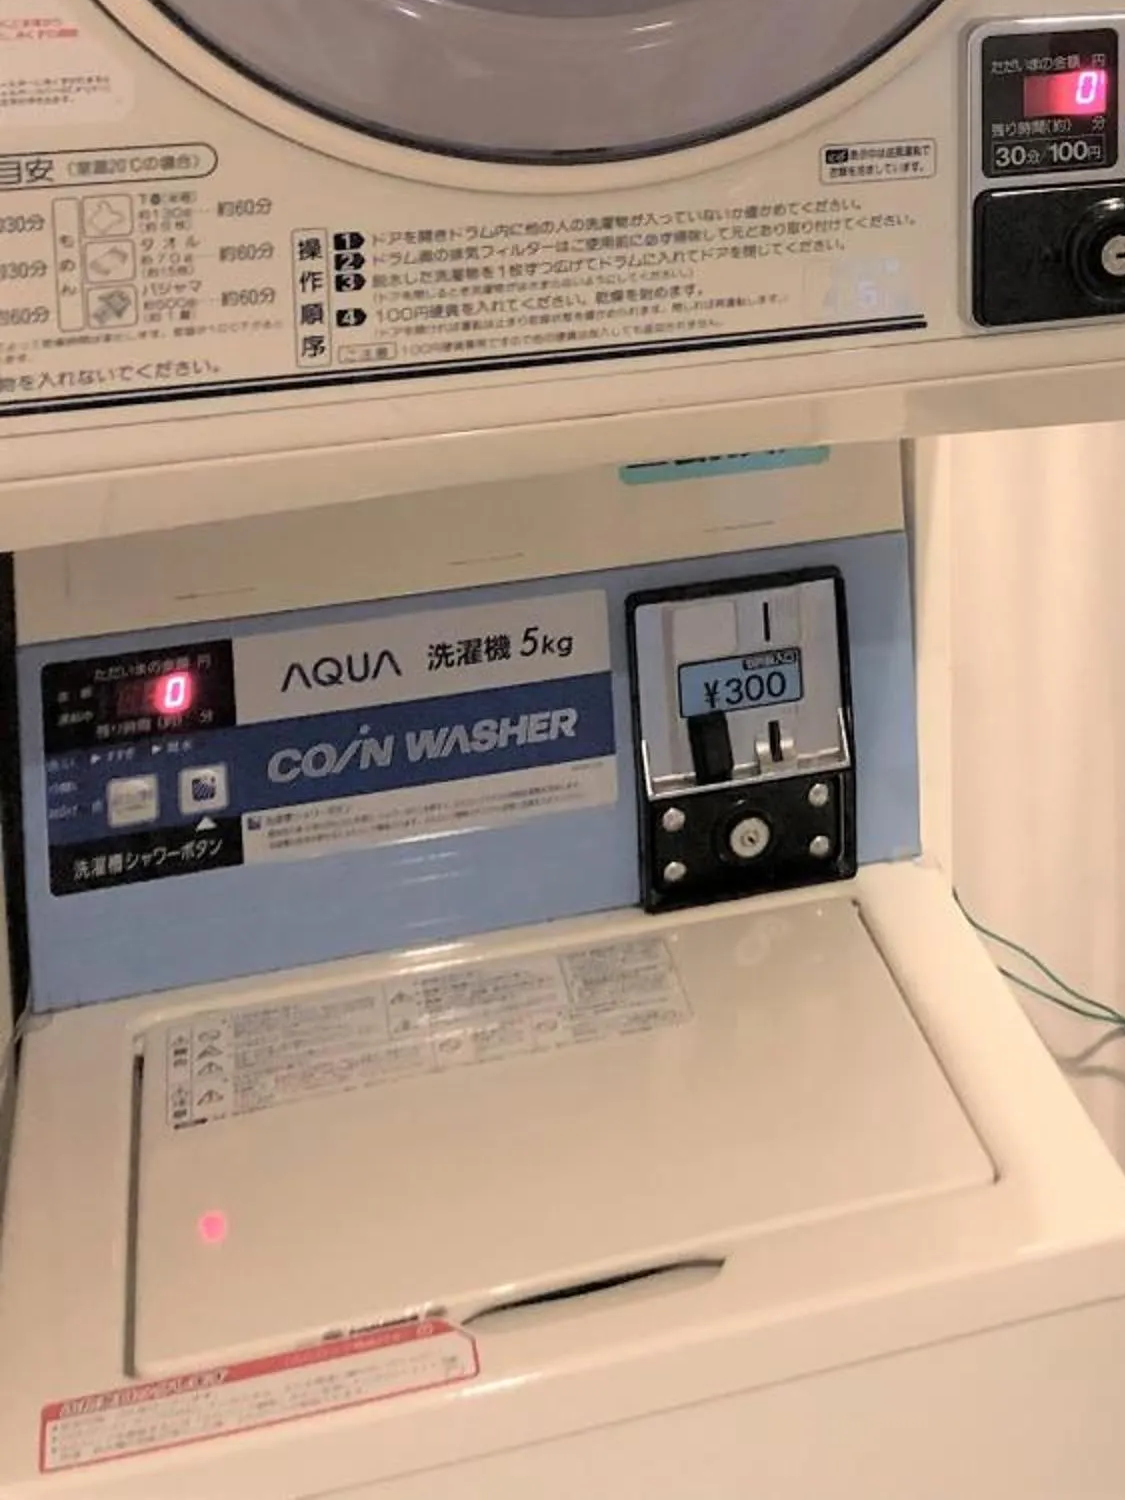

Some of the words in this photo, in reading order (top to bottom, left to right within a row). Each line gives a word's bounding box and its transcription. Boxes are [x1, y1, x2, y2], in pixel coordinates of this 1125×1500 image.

[1075, 70, 1098, 104] 0
[0, 214, 45, 233] 30分
[427, 633, 512, 672] 洗濯機
[520, 626, 574, 658] 5kg
[281, 649, 402, 693] AQUA
[703, 670, 787, 709] ¥300
[164, 675, 186, 709] 0
[267, 724, 394, 784] COIN
[405, 707, 579, 763] WASHER
